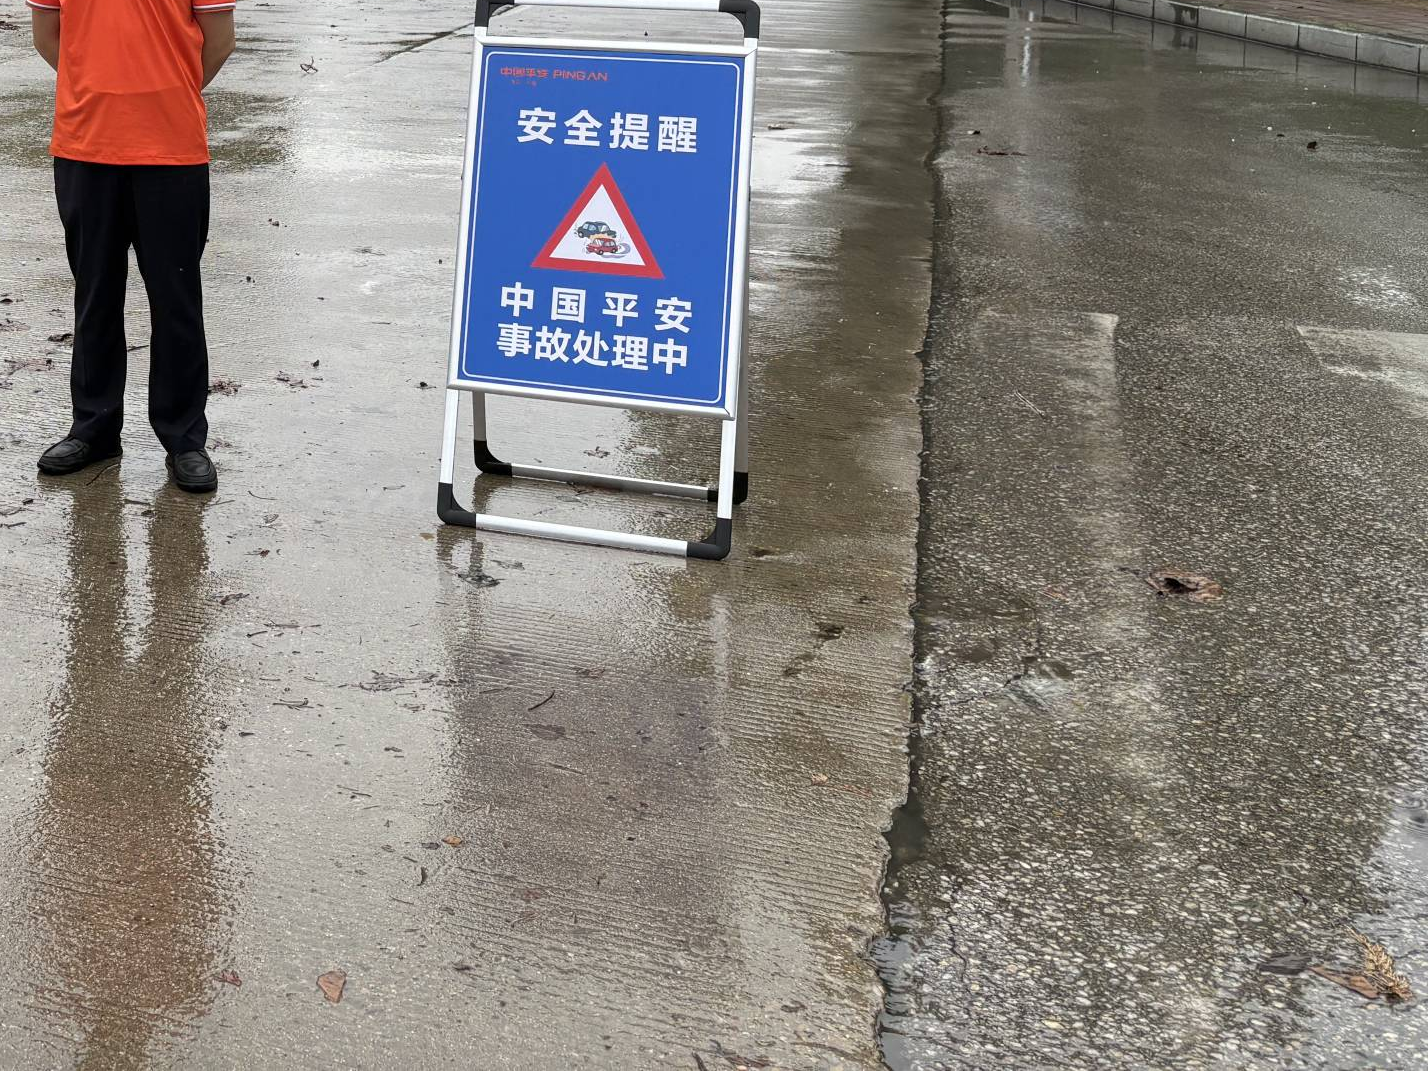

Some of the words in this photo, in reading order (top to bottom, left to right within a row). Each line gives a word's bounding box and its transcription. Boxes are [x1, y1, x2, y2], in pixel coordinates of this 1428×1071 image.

[516, 106, 698, 154] 安全提醒
[500, 281, 693, 334] 中国平安
[496, 322, 688, 375] 事故处理中
